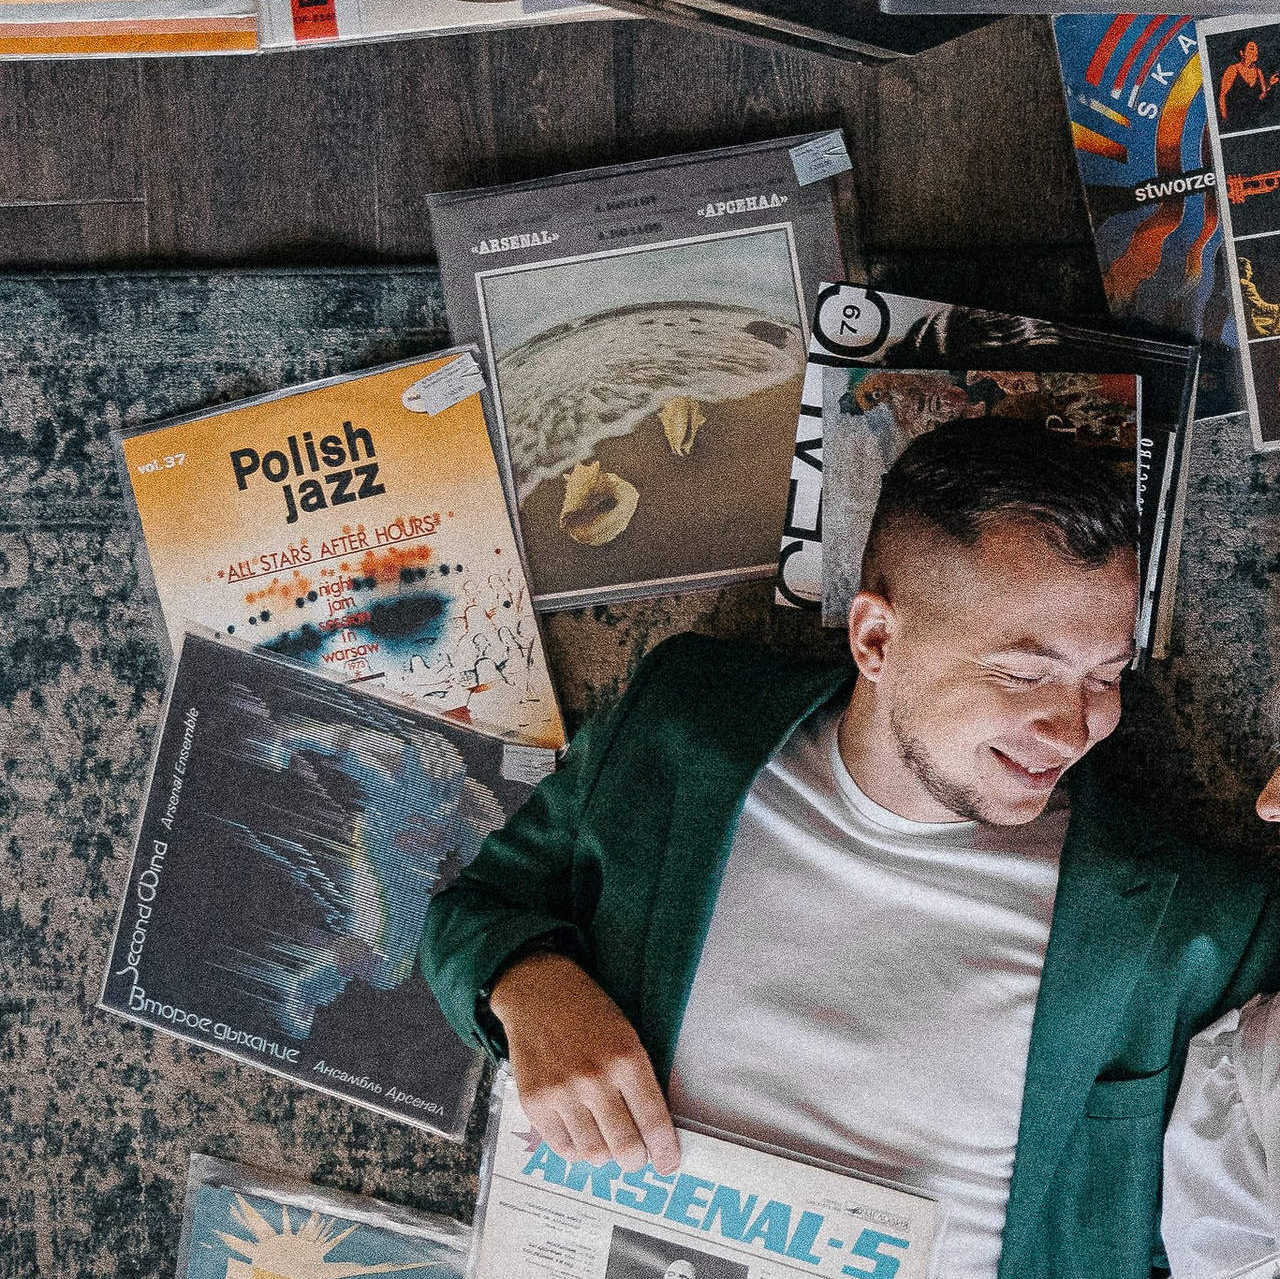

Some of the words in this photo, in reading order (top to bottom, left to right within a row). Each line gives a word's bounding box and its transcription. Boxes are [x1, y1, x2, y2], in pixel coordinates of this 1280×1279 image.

[696, 191, 790, 220] «АРСЕНАЛ»
[469, 228, 562, 258] «ARSENAL»
[840, 303, 861, 338] 79
[229, 420, 376, 491] Polish
[283, 463, 386, 525] jazz
[225, 558, 256, 583] ALL
[259, 544, 313, 574] STARS
[318, 531, 371, 560] AFTER
[374, 514, 437, 546] HOURS
[326, 594, 357, 618] jam
[340, 627, 358, 645] in
[320, 641, 380, 665] warsaw
[162, 776, 185, 831] Arsenal
[177, 706, 200, 775] Ensemble
[116, 900, 151, 986] Second
[126, 986, 212, 1035] Второе
[212, 1022, 301, 1065] дыхание
[312, 1058, 384, 1096] Ансамбль
[385, 1085, 445, 1118] Арсенал
